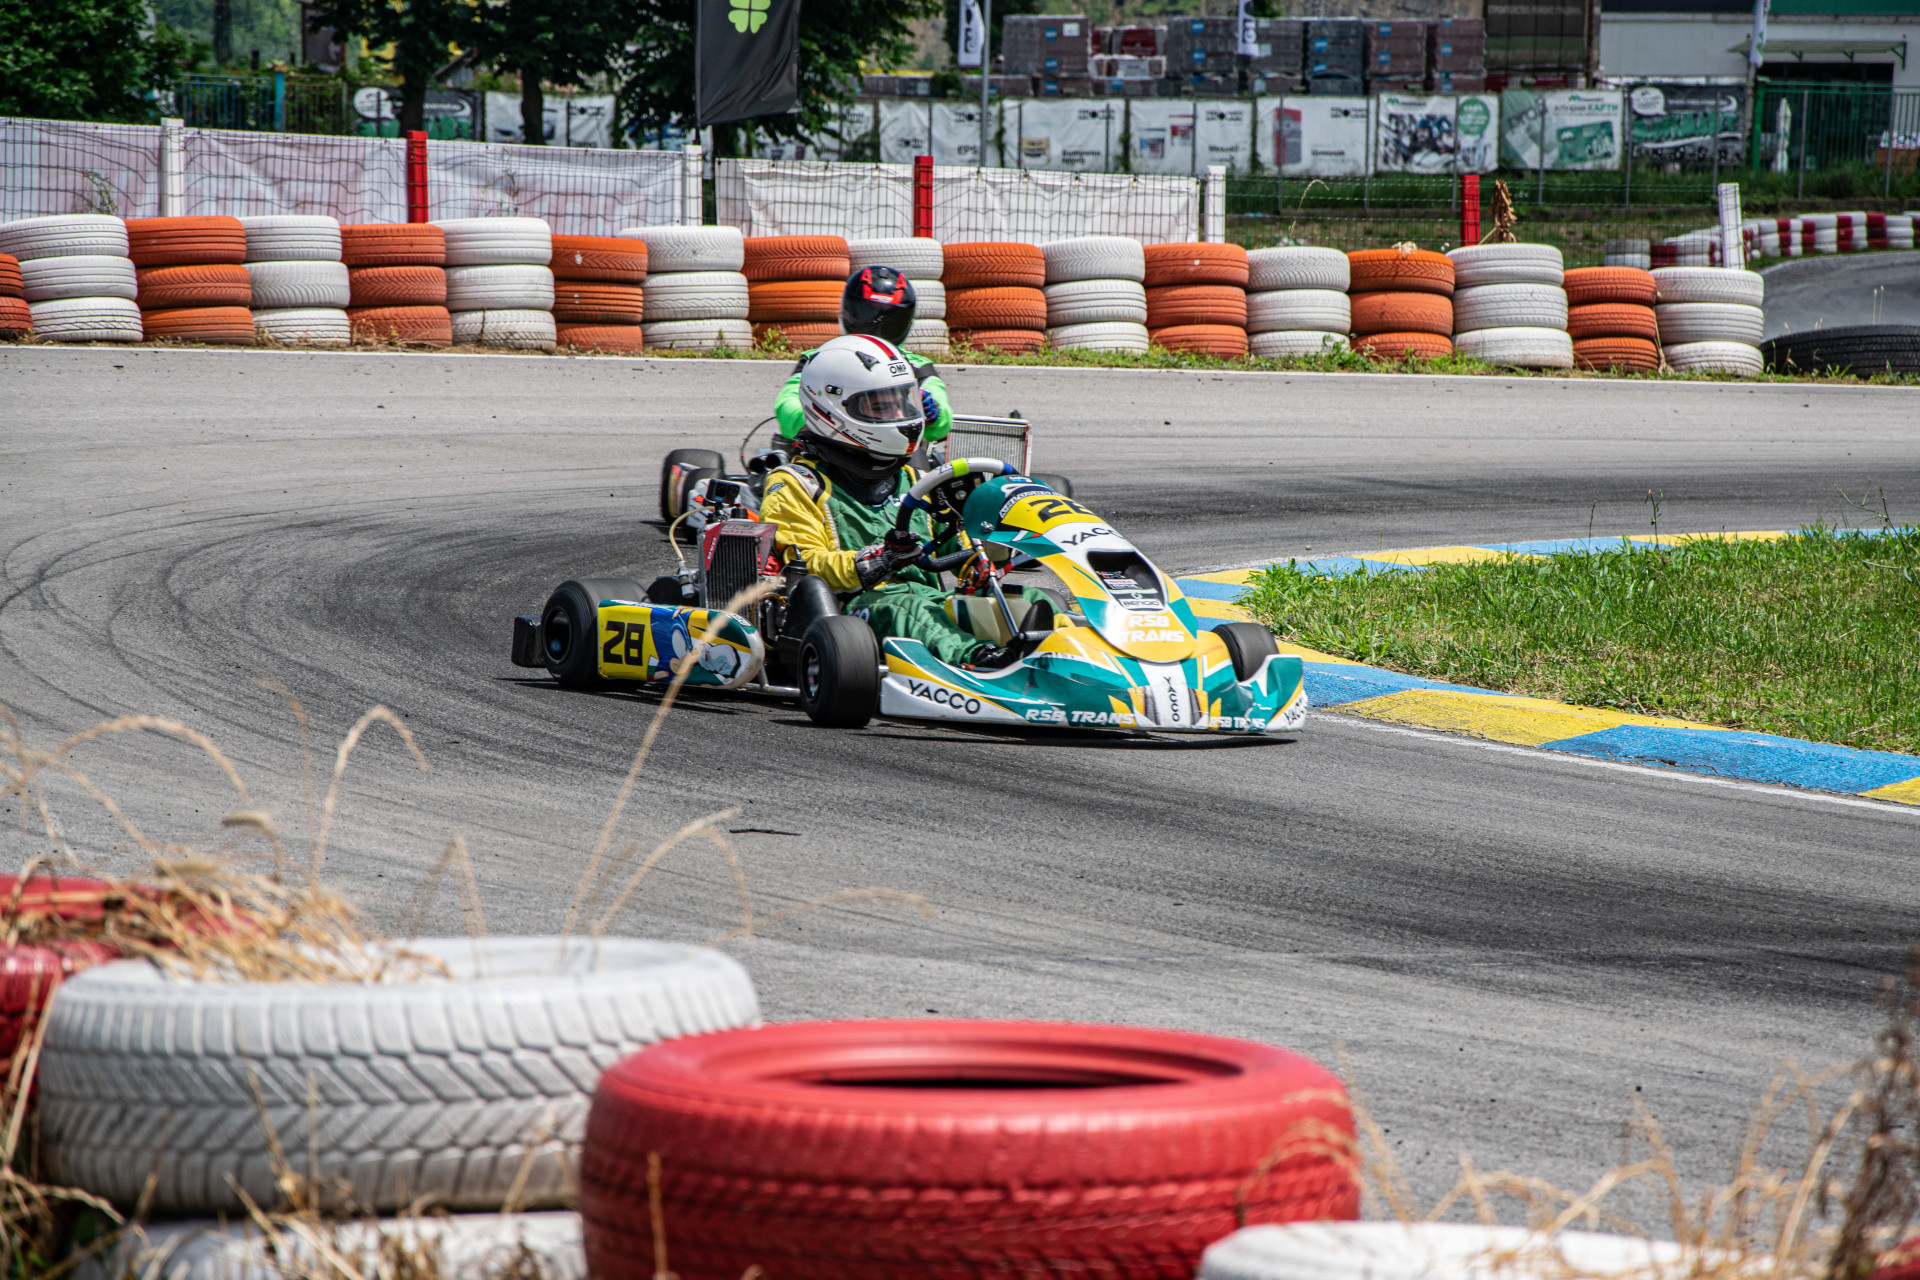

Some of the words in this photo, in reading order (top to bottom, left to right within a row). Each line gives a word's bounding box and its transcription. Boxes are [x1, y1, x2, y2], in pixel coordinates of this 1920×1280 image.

[889, 364, 907, 375] OMP
[1129, 615, 1169, 628] RSB
[603, 620, 645, 666] 28
[1122, 629, 1184, 642] TRANS
[908, 679, 981, 714] YACCO
[1163, 677, 1180, 722] YACCO
[1025, 708, 1066, 722] RSB
[1071, 710, 1135, 725] TRANS
[1210, 716, 1233, 728] RSB
